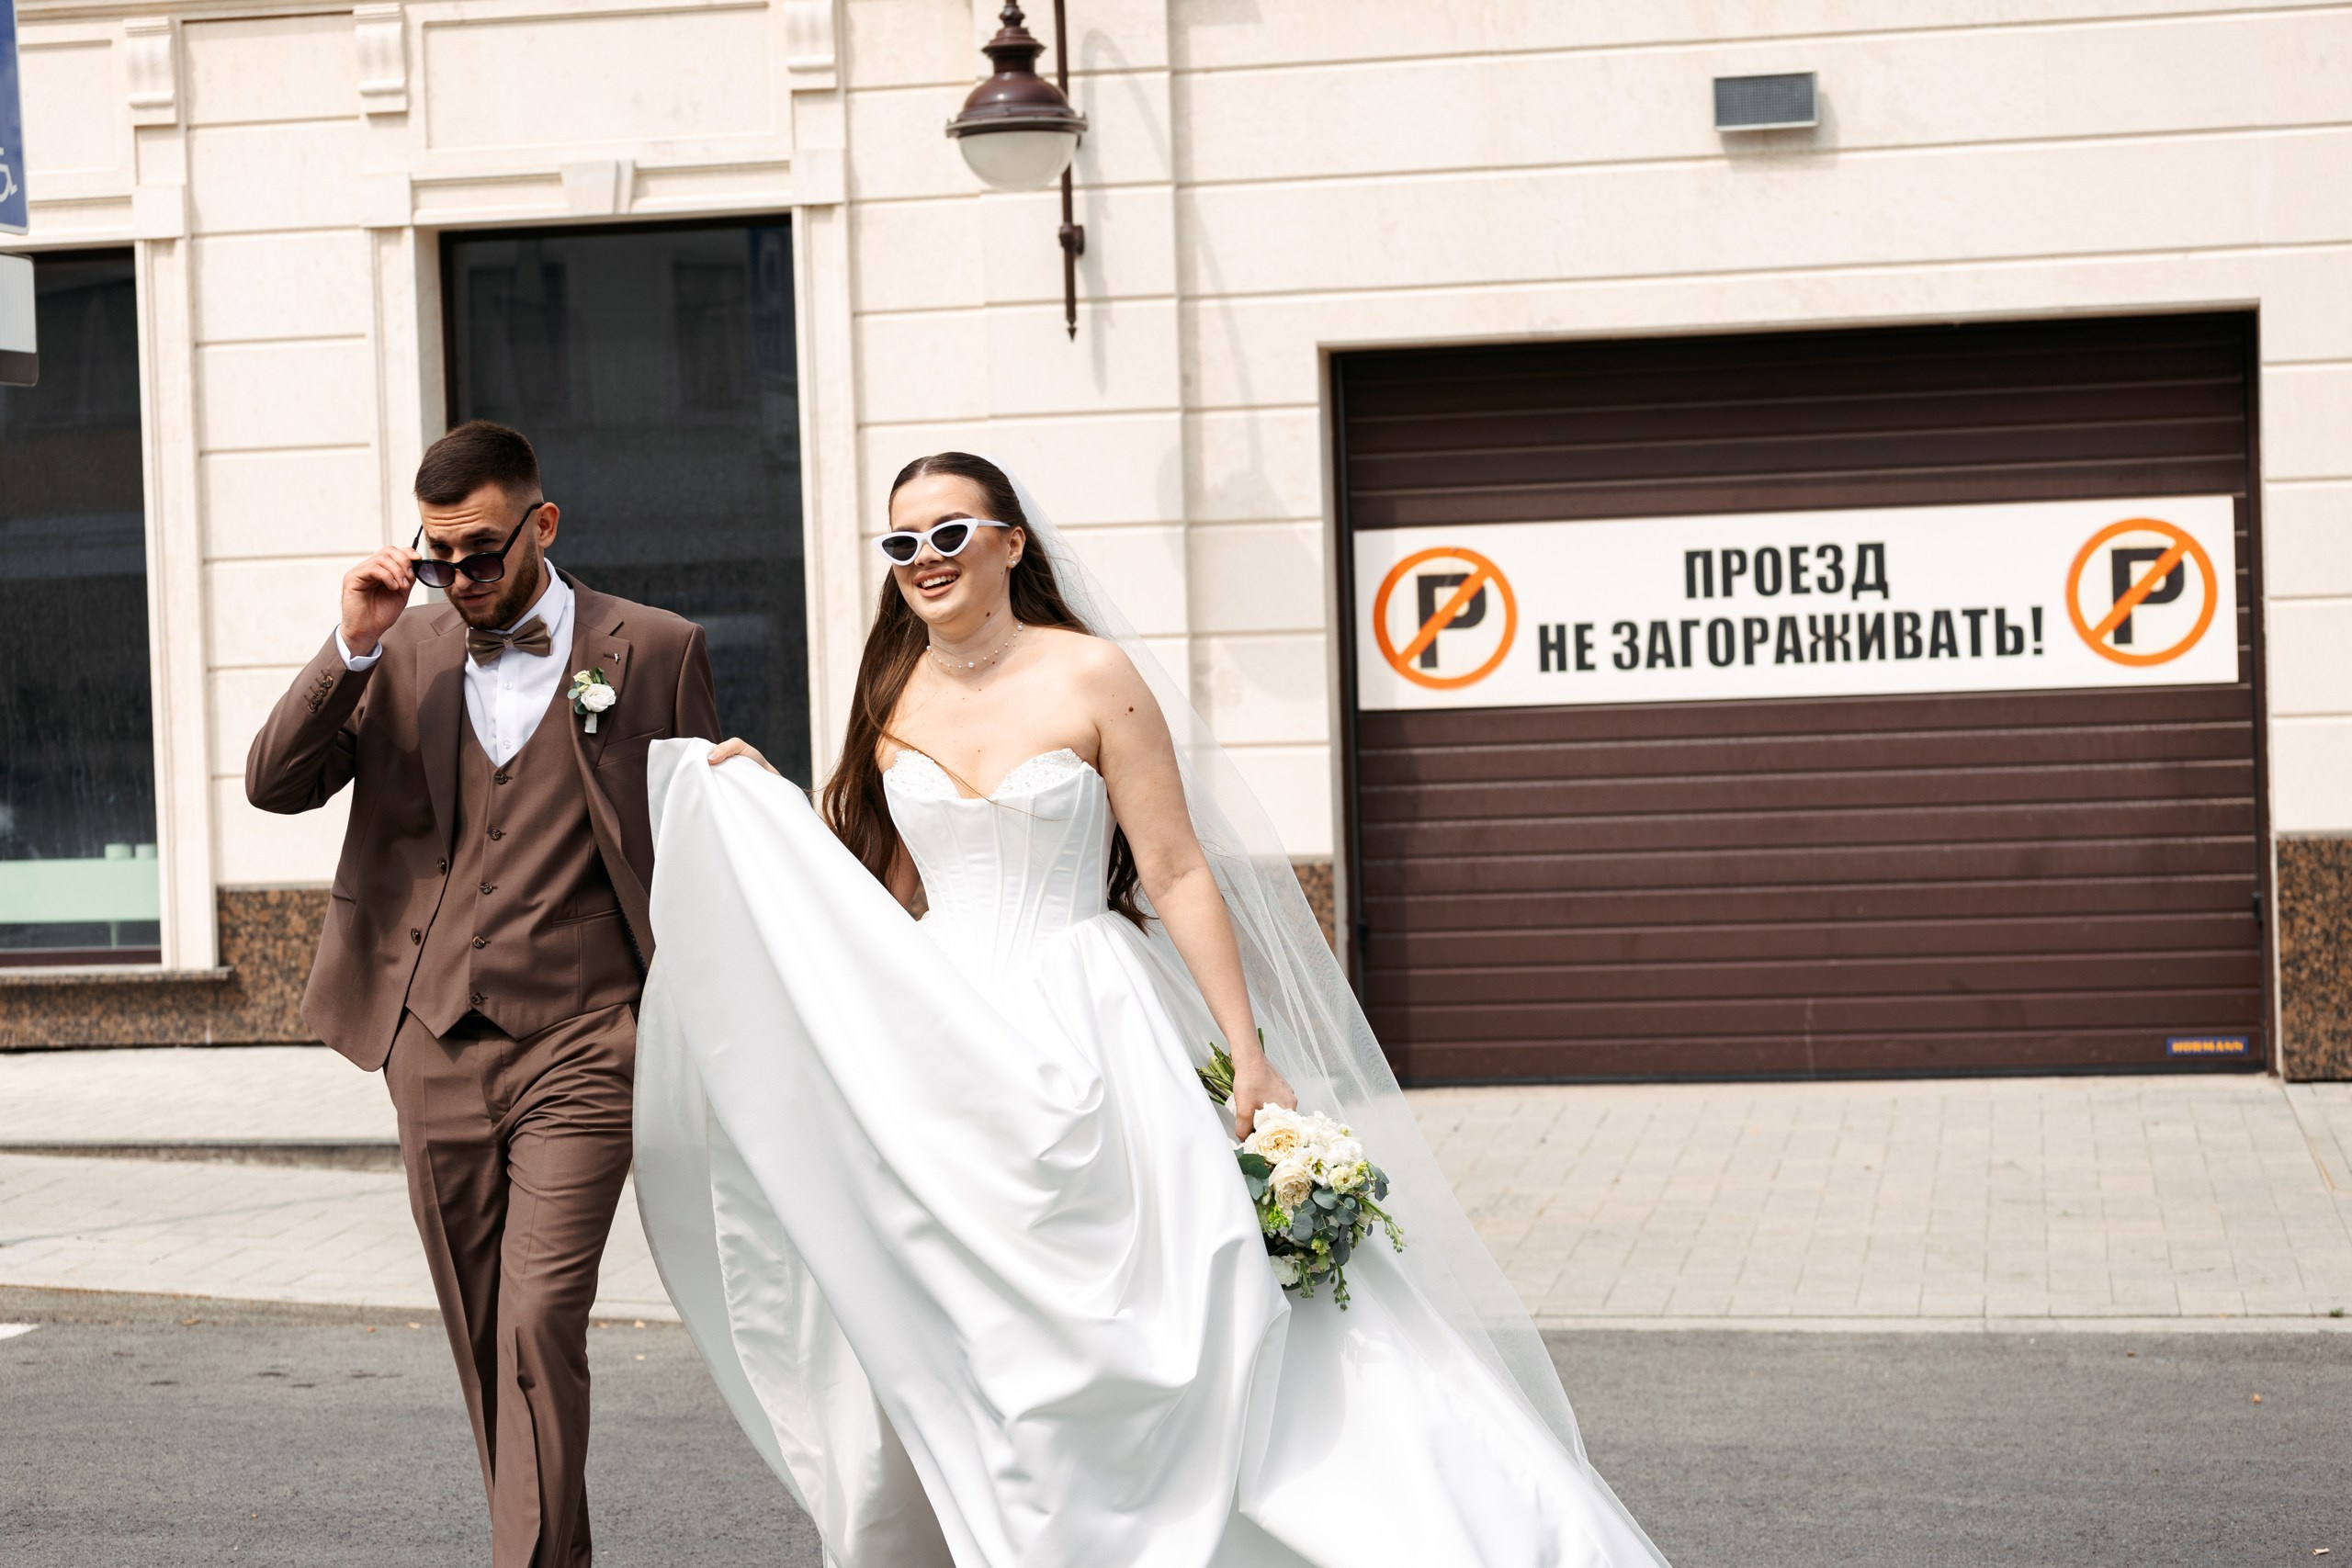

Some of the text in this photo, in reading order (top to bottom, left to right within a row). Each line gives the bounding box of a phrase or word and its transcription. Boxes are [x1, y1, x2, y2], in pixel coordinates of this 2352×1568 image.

[1685, 543, 1889, 601] ПРОЕЗД
[1539, 606, 2043, 672] НЕ ЗАГОРАЖИВАТЬ!
